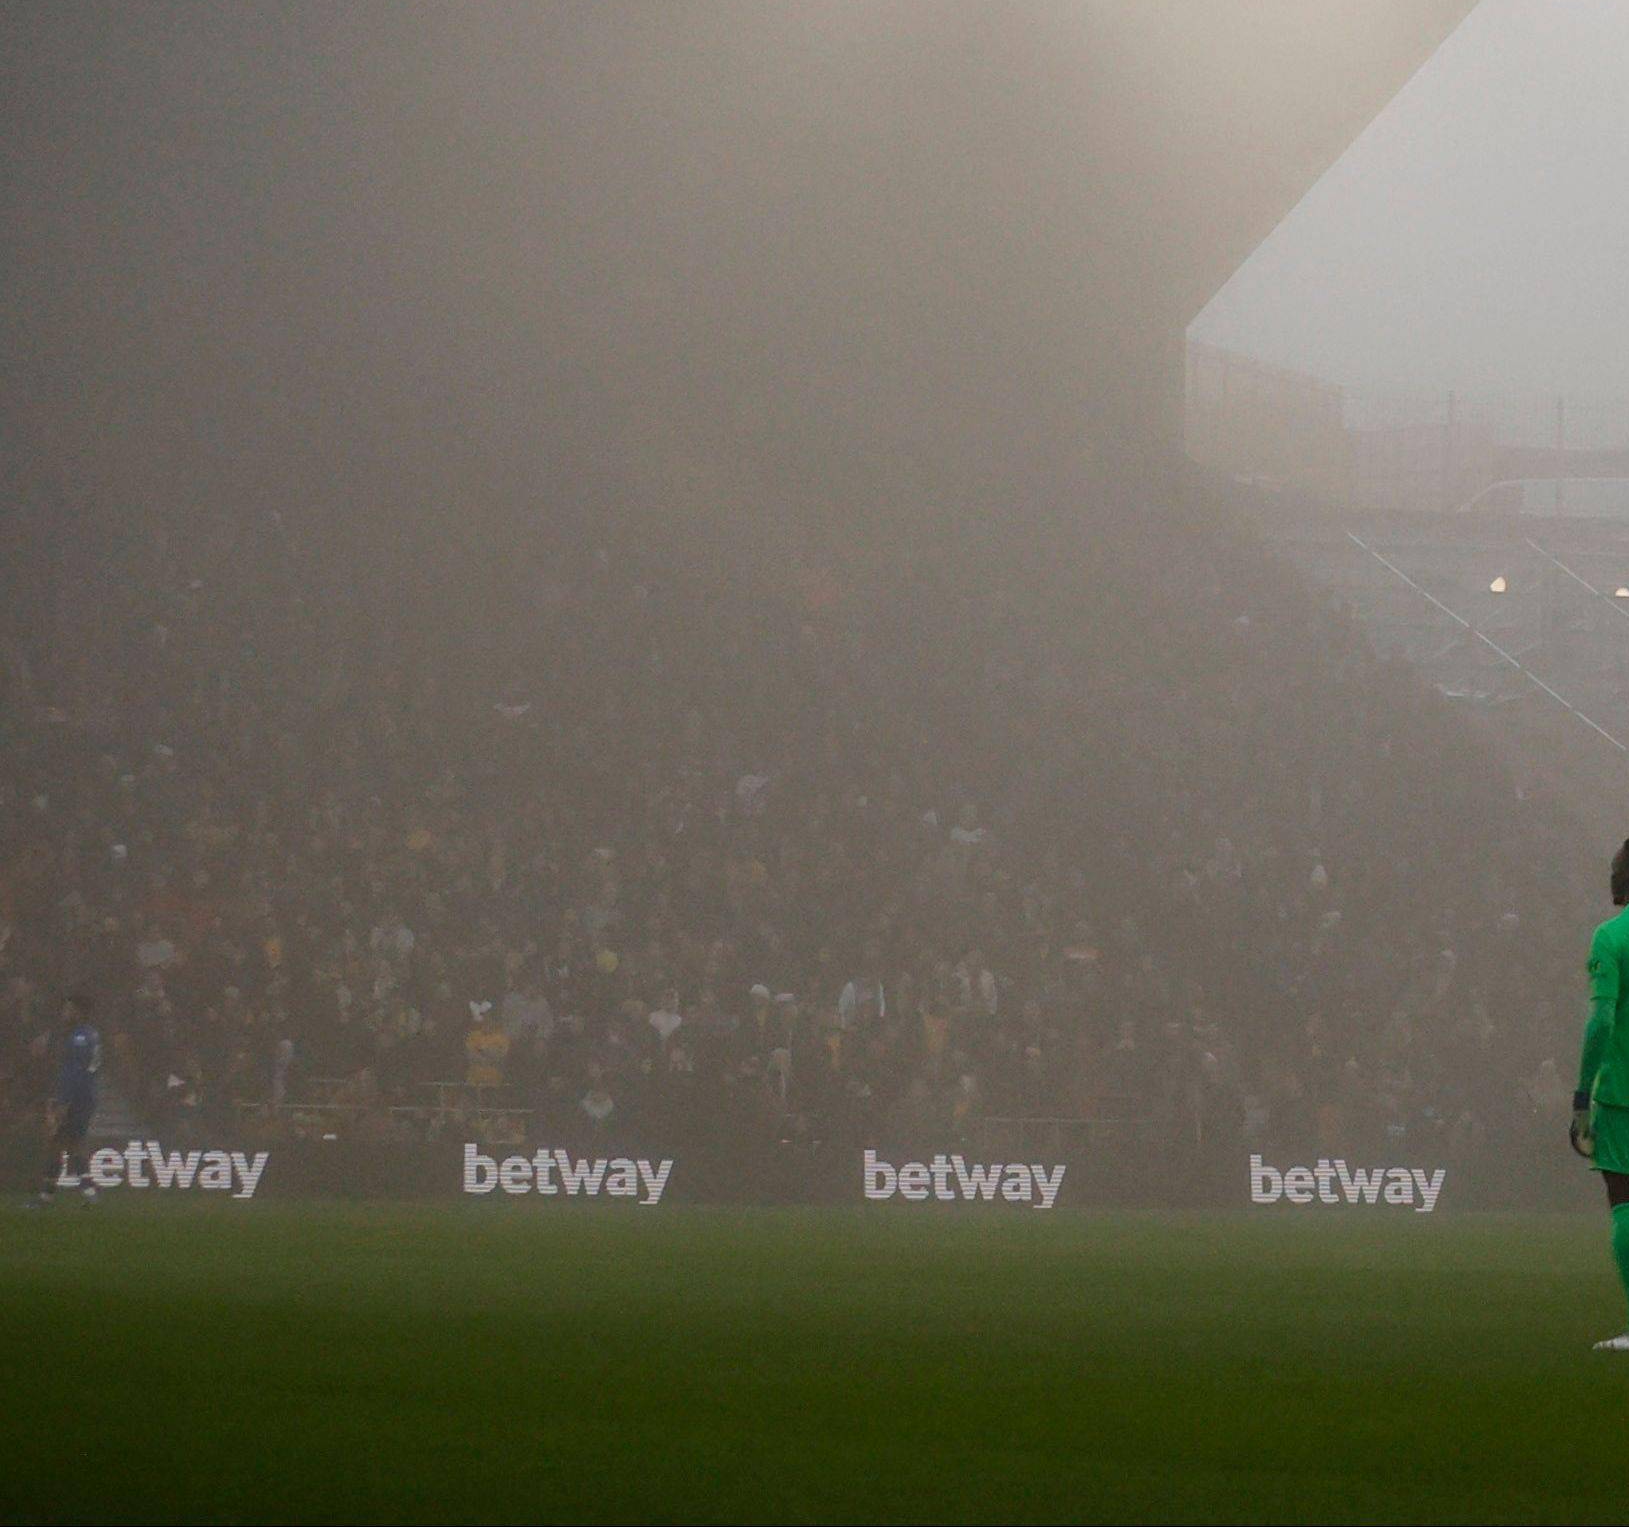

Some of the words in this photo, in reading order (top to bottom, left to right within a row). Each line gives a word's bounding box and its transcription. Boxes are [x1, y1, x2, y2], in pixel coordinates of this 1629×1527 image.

[463, 1143, 674, 1205] betway
[863, 1149, 1066, 1209] betway
[1249, 1154, 1446, 1213] betway
